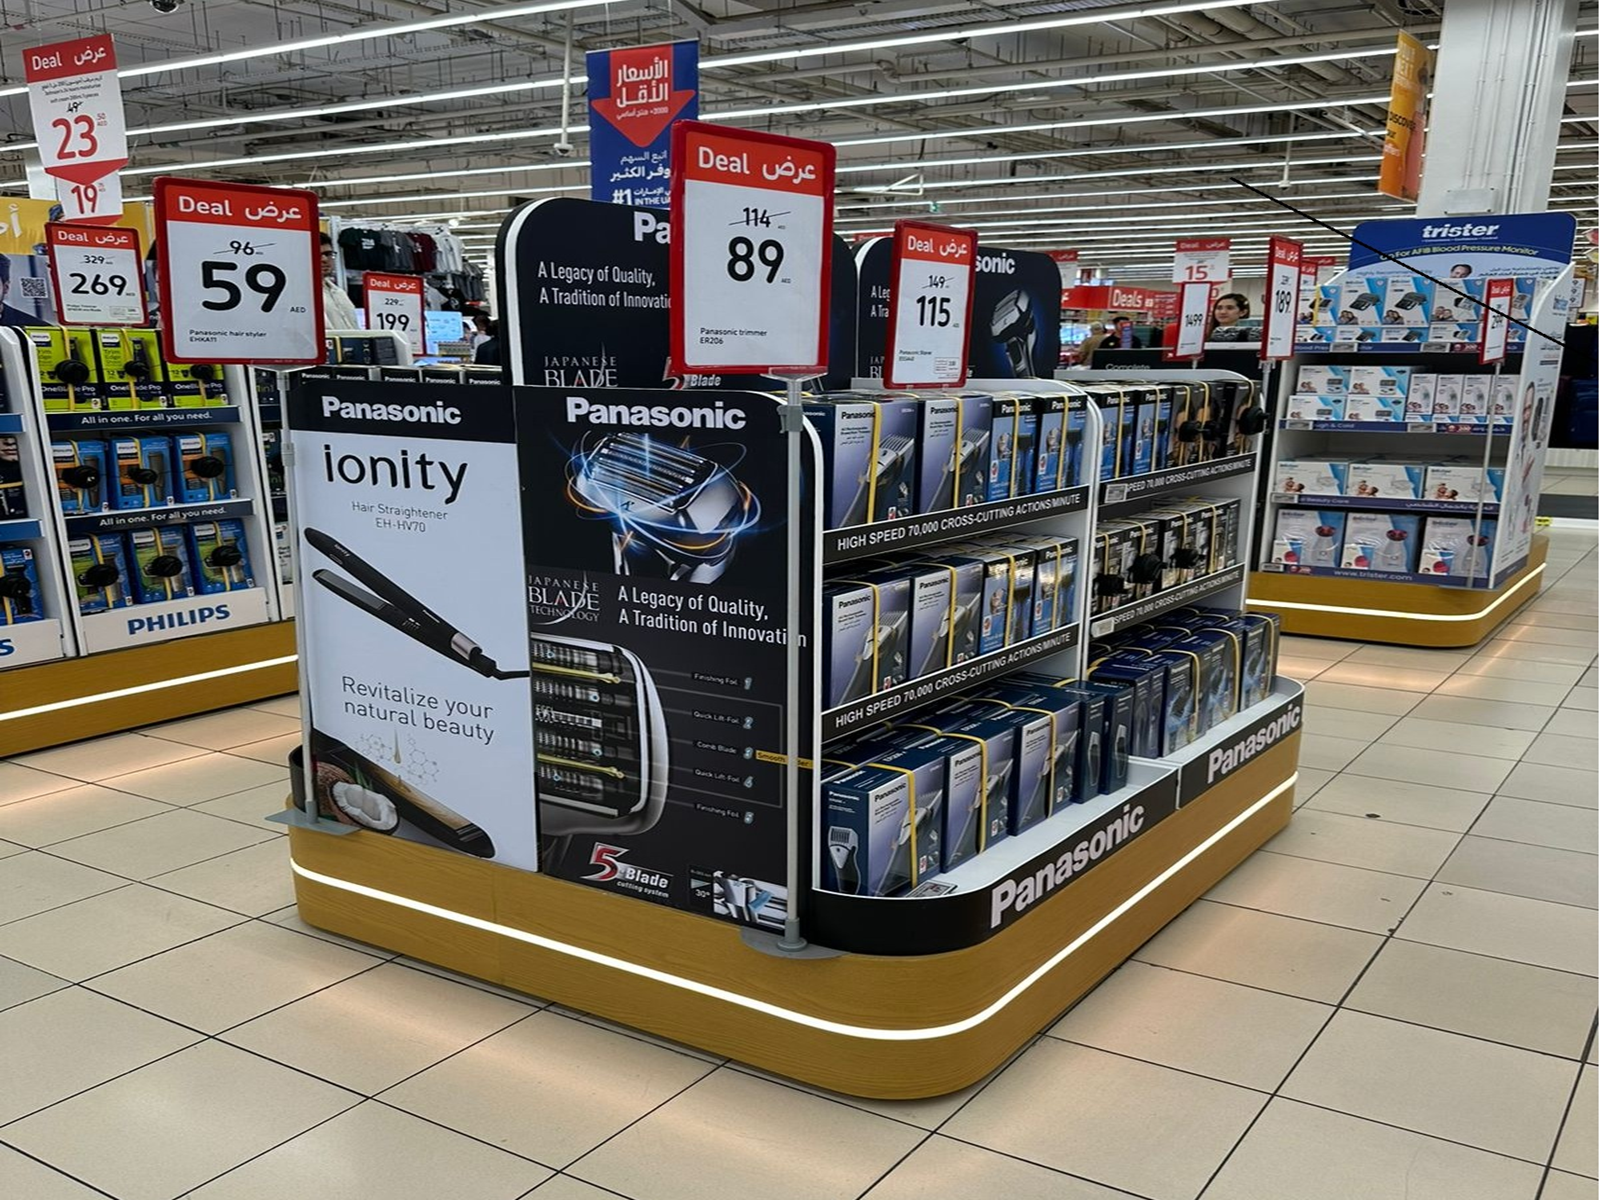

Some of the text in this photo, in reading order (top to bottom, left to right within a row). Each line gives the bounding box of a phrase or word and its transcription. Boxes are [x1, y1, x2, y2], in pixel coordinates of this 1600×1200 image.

[31, 51, 62, 71] Deal
[73, 45, 106, 66] عرض
[616, 56, 669, 87] الأسعار
[616, 80, 669, 108] الأقل
[52, 114, 98, 160] 23
[698, 146, 750, 175] Deal
[762, 156, 816, 184] عرض
[71, 184, 98, 215] 19
[178, 195, 232, 216] Deal
[612, 188, 632, 205] #1
[245, 201, 302, 223] عرض
[743, 207, 771, 228] 114
[58, 230, 89, 243] Deal
[95, 231, 129, 245] عرض
[1422, 223, 1500, 239] trister
[229, 240, 255, 256] 96
[907, 235, 934, 253] Deal
[939, 239, 968, 258] عرض
[1431, 244, 1539, 256] Blood Pressure Monitor
[83, 255, 105, 265] 329
[727, 236, 785, 284] 89
[975, 252, 1016, 275] sonic
[538, 261, 656, 287] A Legacy of Quality,
[928, 275, 945, 289] 149
[1184, 265, 1209, 281] 15
[69, 272, 128, 296] 269
[201, 260, 287, 313] 59
[370, 278, 391, 289] Deal
[394, 279, 417, 290] عرض
[871, 285, 877, 298] A
[540, 288, 620, 307] A Tradition of
[1112, 288, 1143, 308] Deals
[1275, 289, 1292, 314] 189
[290, 306, 307, 314] AED
[871, 305, 877, 317] A
[916, 295, 951, 327] 115
[376, 312, 410, 331] 199
[1185, 313, 1203, 327] 1499
[189, 329, 228, 338] Panasonic
[228, 330, 243, 338] hair
[700, 327, 768, 337] Panasonic trimmer
[700, 336, 724, 345] ER206
[544, 355, 617, 368] JAPANESE
[1105, 362, 1150, 370] Complete
[210, 382, 223, 390] Pro
[544, 369, 619, 387] BLADE
[149, 384, 162, 392] Pro
[81, 416, 96, 425] All
[97, 415, 109, 424] in
[134, 414, 149, 422] For
[150, 413, 165, 421] all
[166, 414, 182, 422] you
[184, 411, 213, 420] need.
[321, 395, 462, 425] Panasonic
[566, 396, 746, 430] Panasonic
[323, 444, 468, 505] ionity
[1165, 467, 1211, 486] CROSS-CUTTING
[100, 506, 227, 527] All in one. For all you need.
[351, 501, 448, 520] Hair Straightener
[375, 517, 426, 533] EH-HV70
[837, 534, 867, 551] HIGH
[869, 527, 906, 545] SPEED
[907, 520, 939, 538] 70,000
[940, 506, 1014, 530] CROSS-CUTTING
[528, 575, 599, 592] JAPANESE
[919, 577, 949, 590] Panasonic
[1334, 570, 1413, 582] www.trister.com
[528, 586, 600, 611] BLADE
[618, 585, 769, 621] A Legacy of Quality,
[838, 595, 872, 609] Panasonic
[127, 604, 231, 635] PHILIPS
[529, 604, 600, 622] TECHNOLOGY
[619, 608, 807, 648] A Tradition of Innovatin
[694, 673, 724, 685] Finishing
[342, 676, 494, 719] Revitalize your
[835, 710, 864, 728] HIGH
[866, 697, 901, 717] SPEED
[903, 685, 934, 704] 70,000
[935, 659, 1007, 691] CROSS-CUTTING
[344, 701, 494, 745] natural beauty
[694, 711, 712, 720] Quick
[743, 716, 753, 730] 2
[1207, 703, 1300, 783] Panasonic
[695, 769, 713, 778] Quick
[874, 782, 907, 802] Panasonic
[696, 804, 726, 816] Finishing
[990, 803, 1145, 929] Panasonic
[616, 881, 669, 898] cutting system
